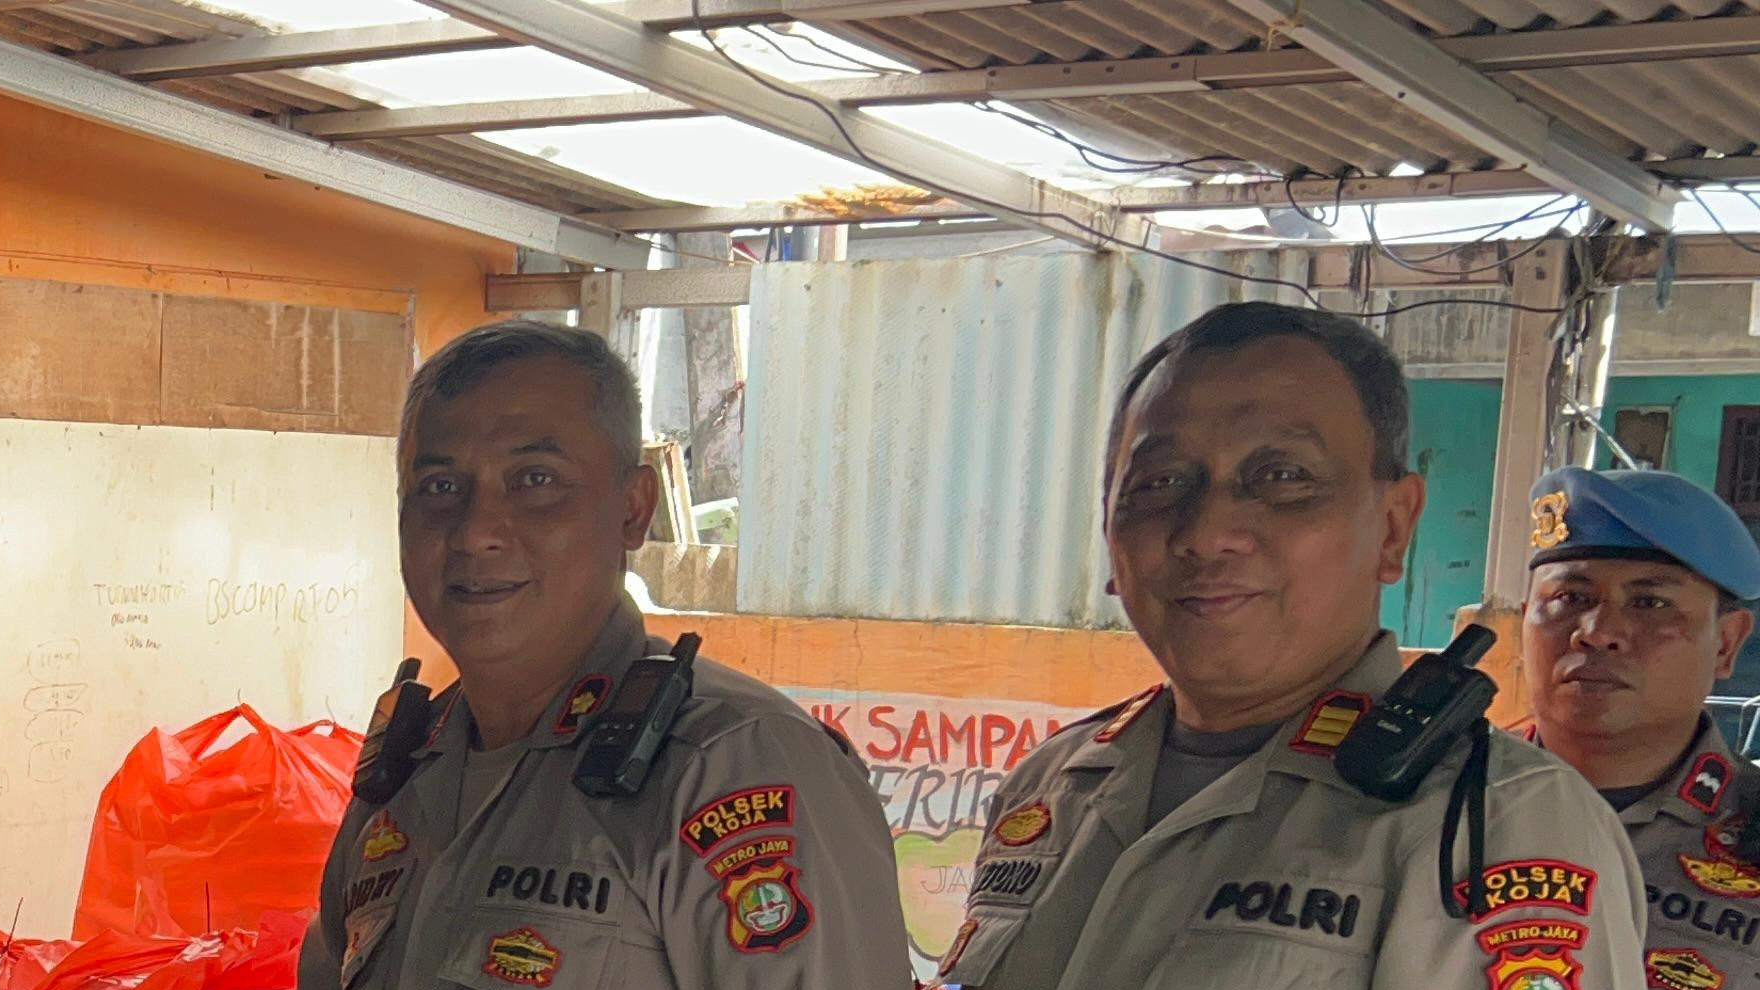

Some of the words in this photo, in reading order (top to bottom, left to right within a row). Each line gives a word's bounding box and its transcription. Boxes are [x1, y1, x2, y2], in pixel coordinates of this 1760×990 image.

[688, 791, 784, 840] POLSEK
[713, 810, 766, 838] KOJA
[713, 845, 756, 874] METRO
[758, 840, 789, 855] JAYA
[486, 865, 611, 914] POLRI
[920, 865, 978, 895] JA
[1465, 866, 1587, 893] OLSEK
[1205, 880, 1361, 938] POLRI
[1485, 882, 1572, 909] KOJA
[1487, 926, 1540, 946] METRO
[1543, 926, 1579, 941] JAYA
